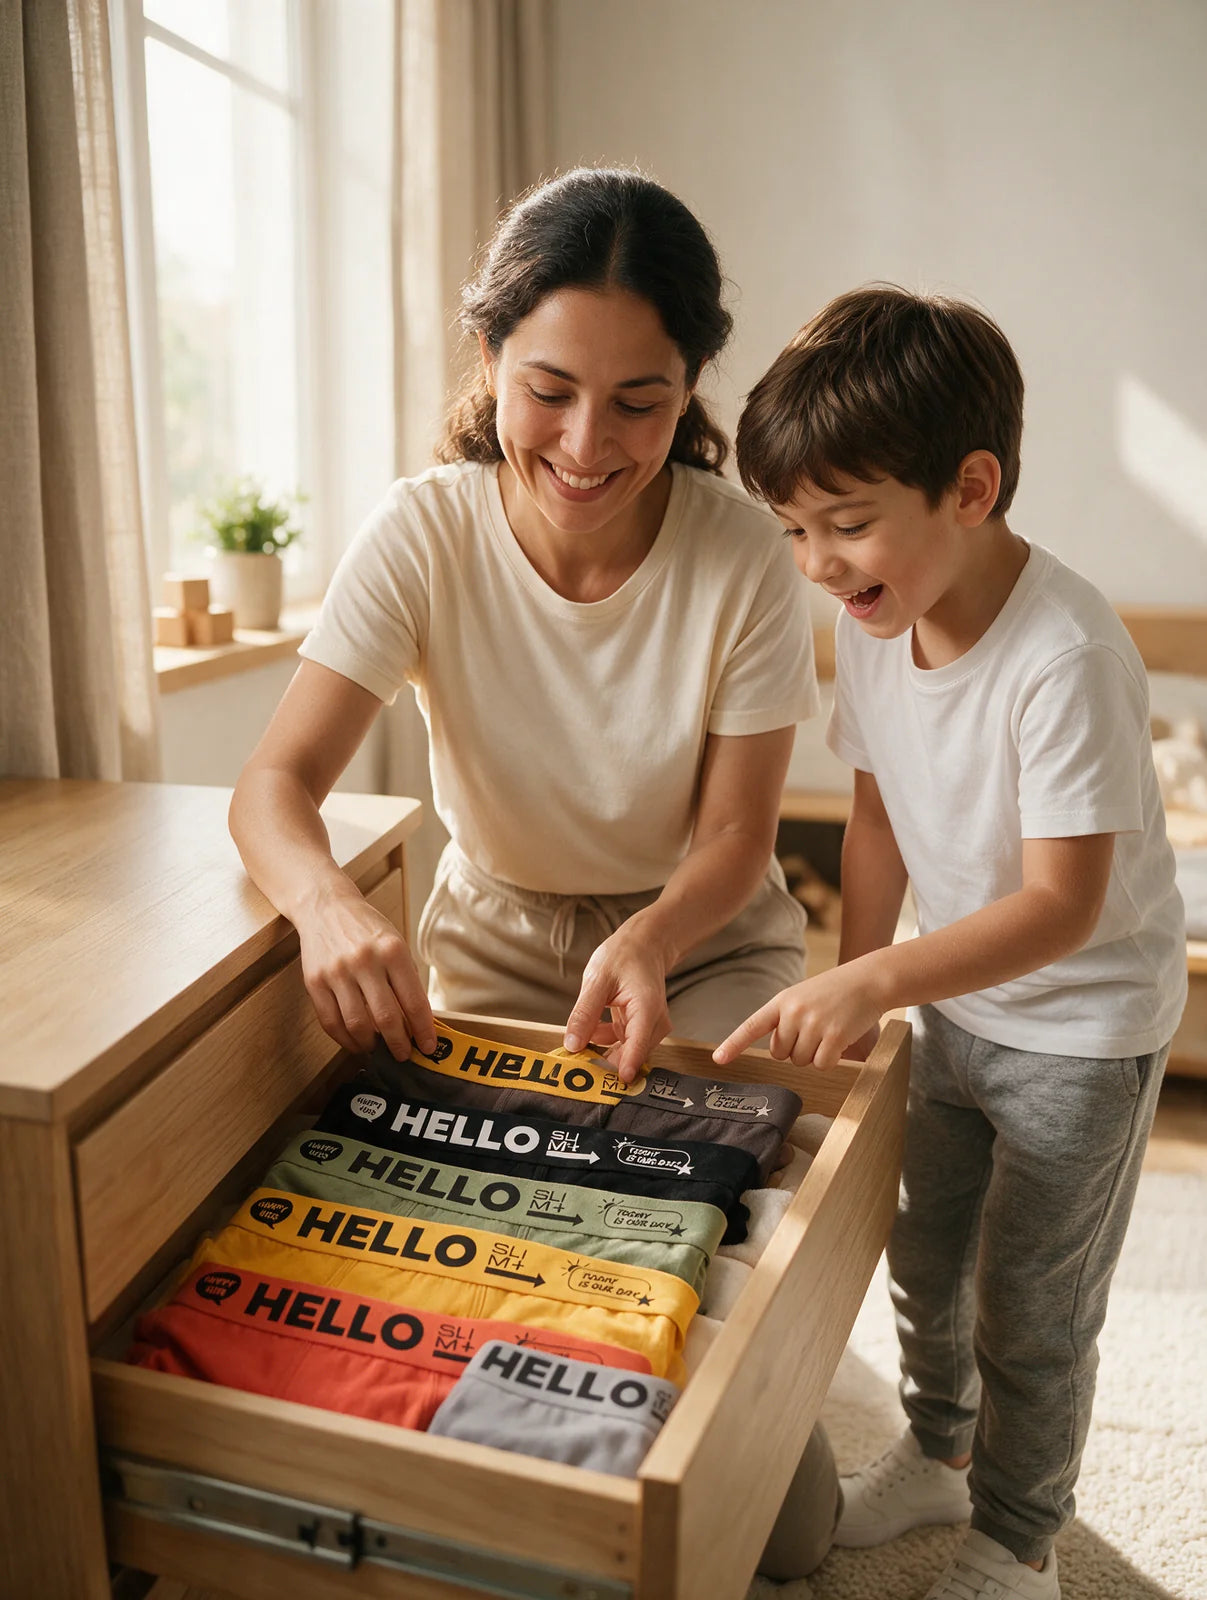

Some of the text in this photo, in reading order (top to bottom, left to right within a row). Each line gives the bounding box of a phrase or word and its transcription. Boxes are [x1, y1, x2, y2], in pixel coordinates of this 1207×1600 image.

[390, 1103, 540, 1154] HELLO
[348, 1150, 521, 1212] HELLO
[533, 1189, 567, 1203] SLI
[529, 1199, 565, 1213] M+
[296, 1206, 477, 1267] HELLO
[492, 1242, 527, 1261] SLI
[487, 1254, 525, 1271] M+
[591, 1282, 614, 1294] OUR
[244, 1282, 424, 1351] HELLO
[438, 1323, 475, 1340] SLI
[435, 1337, 475, 1353] M+
[480, 1346, 648, 1409] HELLO
